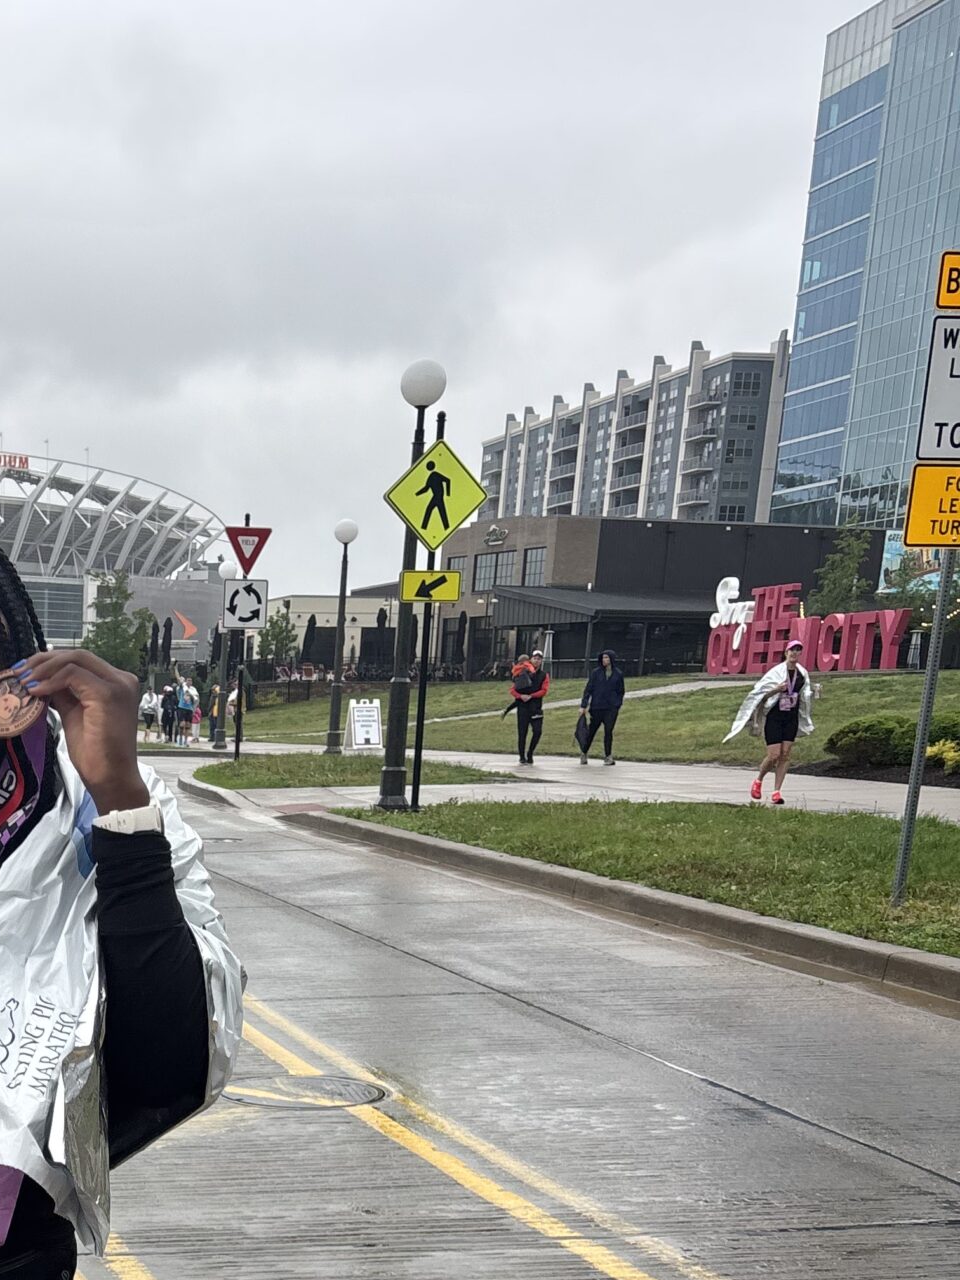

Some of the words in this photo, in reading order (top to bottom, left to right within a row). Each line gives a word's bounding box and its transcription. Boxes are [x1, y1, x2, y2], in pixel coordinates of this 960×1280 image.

[752, 583, 802, 621] THE
[707, 615, 821, 676] QUEEN
[817, 608, 913, 671] CITY
[28, 1011, 78, 1095] MARATHO
